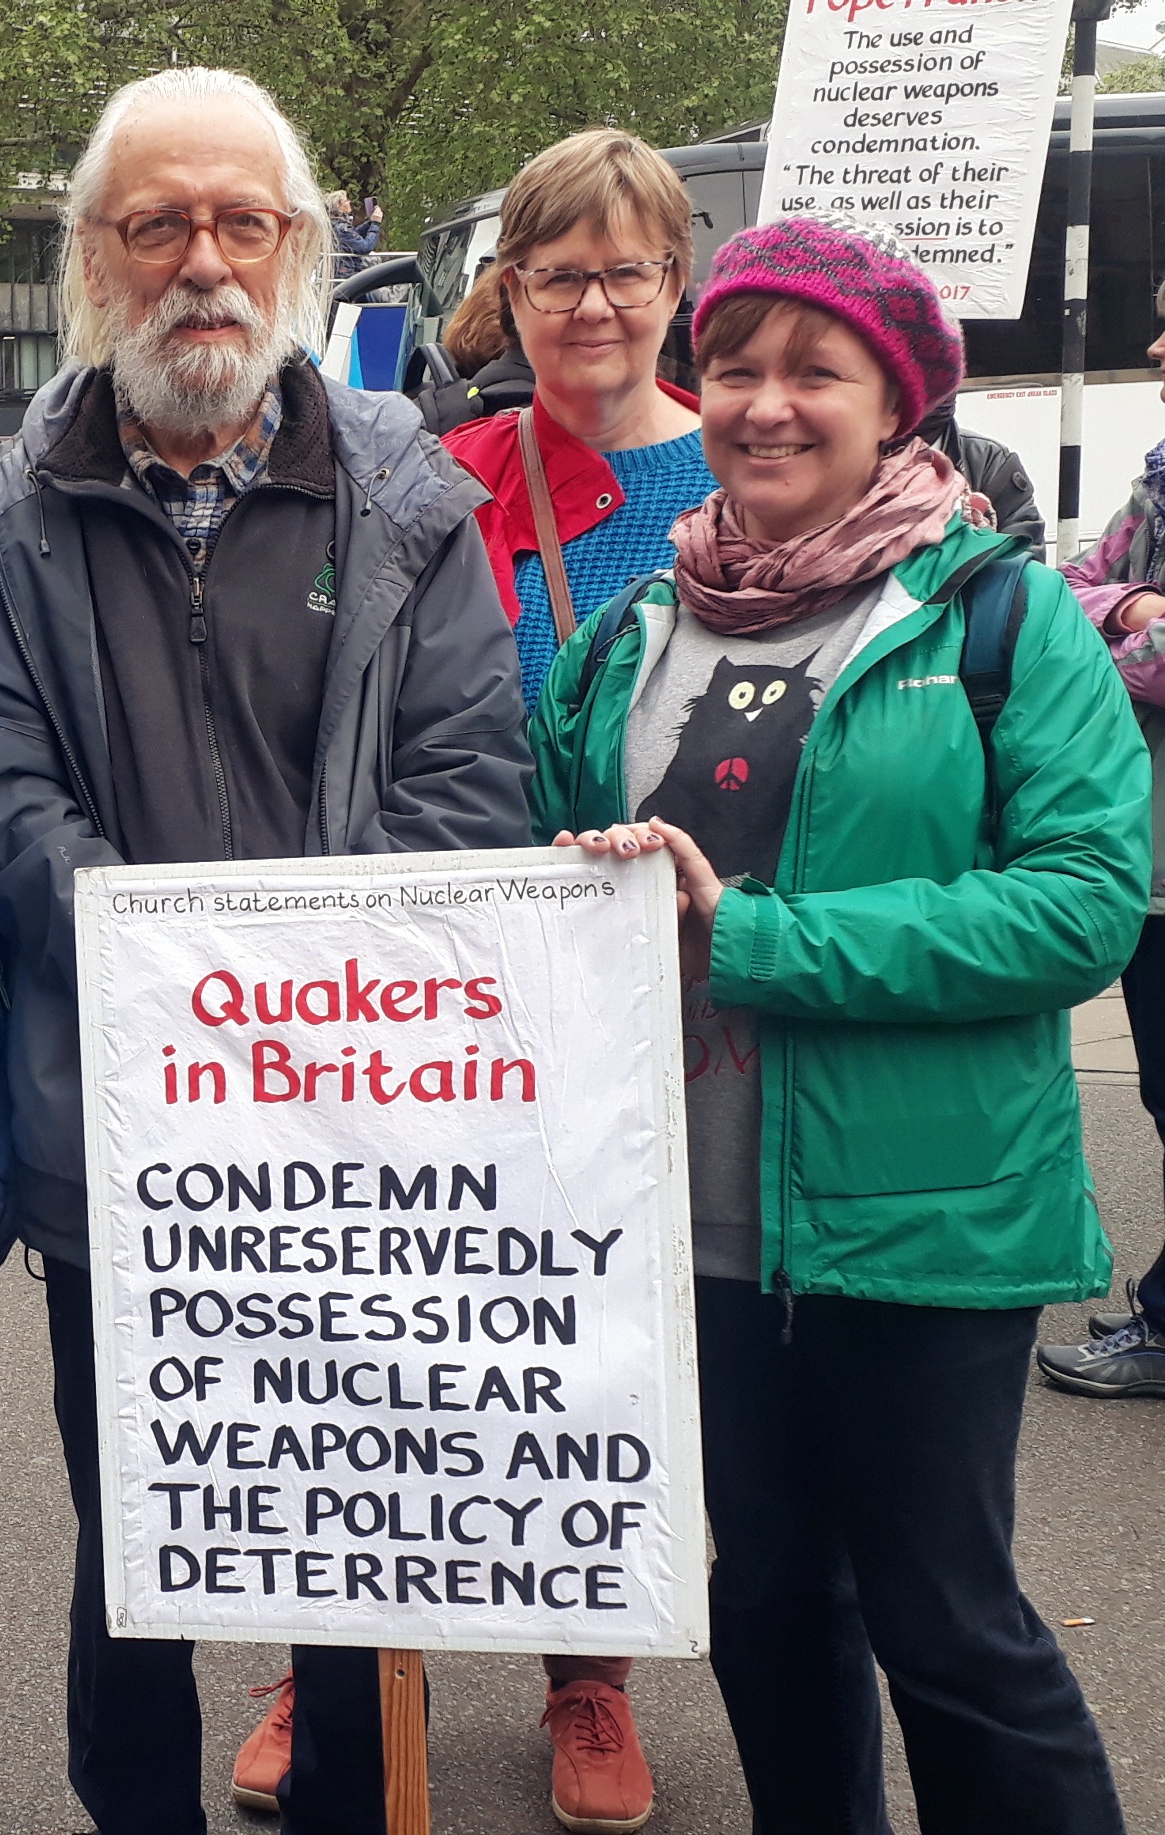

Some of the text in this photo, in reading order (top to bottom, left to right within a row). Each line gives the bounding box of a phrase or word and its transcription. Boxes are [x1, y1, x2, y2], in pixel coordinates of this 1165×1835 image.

[843, 24, 974, 49] The use and
[828, 51, 986, 82] possession of
[813, 80, 999, 104] nuclear weapons
[843, 108, 943, 128] deserves
[810, 132, 981, 155] condemnation.
[842, 163, 913, 185] threat
[919, 161, 944, 185] of
[951, 160, 1010, 183] their
[830, 196, 855, 211] as
[861, 190, 901, 210] well
[907, 194, 932, 210] as
[939, 189, 1000, 210] their
[895, 216, 1004, 237] ssion is to
[940, 285, 972, 300] 017
[308, 592, 336, 606] CRA
[112, 877, 615, 915] Church statements on Nuclear Weapons
[191, 958, 502, 1028] Quakers
[161, 1039, 536, 1105] in Britain
[136, 1161, 497, 1212] CONDEMN
[143, 1223, 623, 1277] UNRESERVEDLY
[150, 1288, 577, 1346] POSSESSION
[149, 1356, 567, 1414] OF NUCLEAR
[150, 1418, 651, 1484] WEAPONS AND
[148, 1482, 647, 1551] THE POLICY OF
[159, 1544, 628, 1610] DETERRENCE
